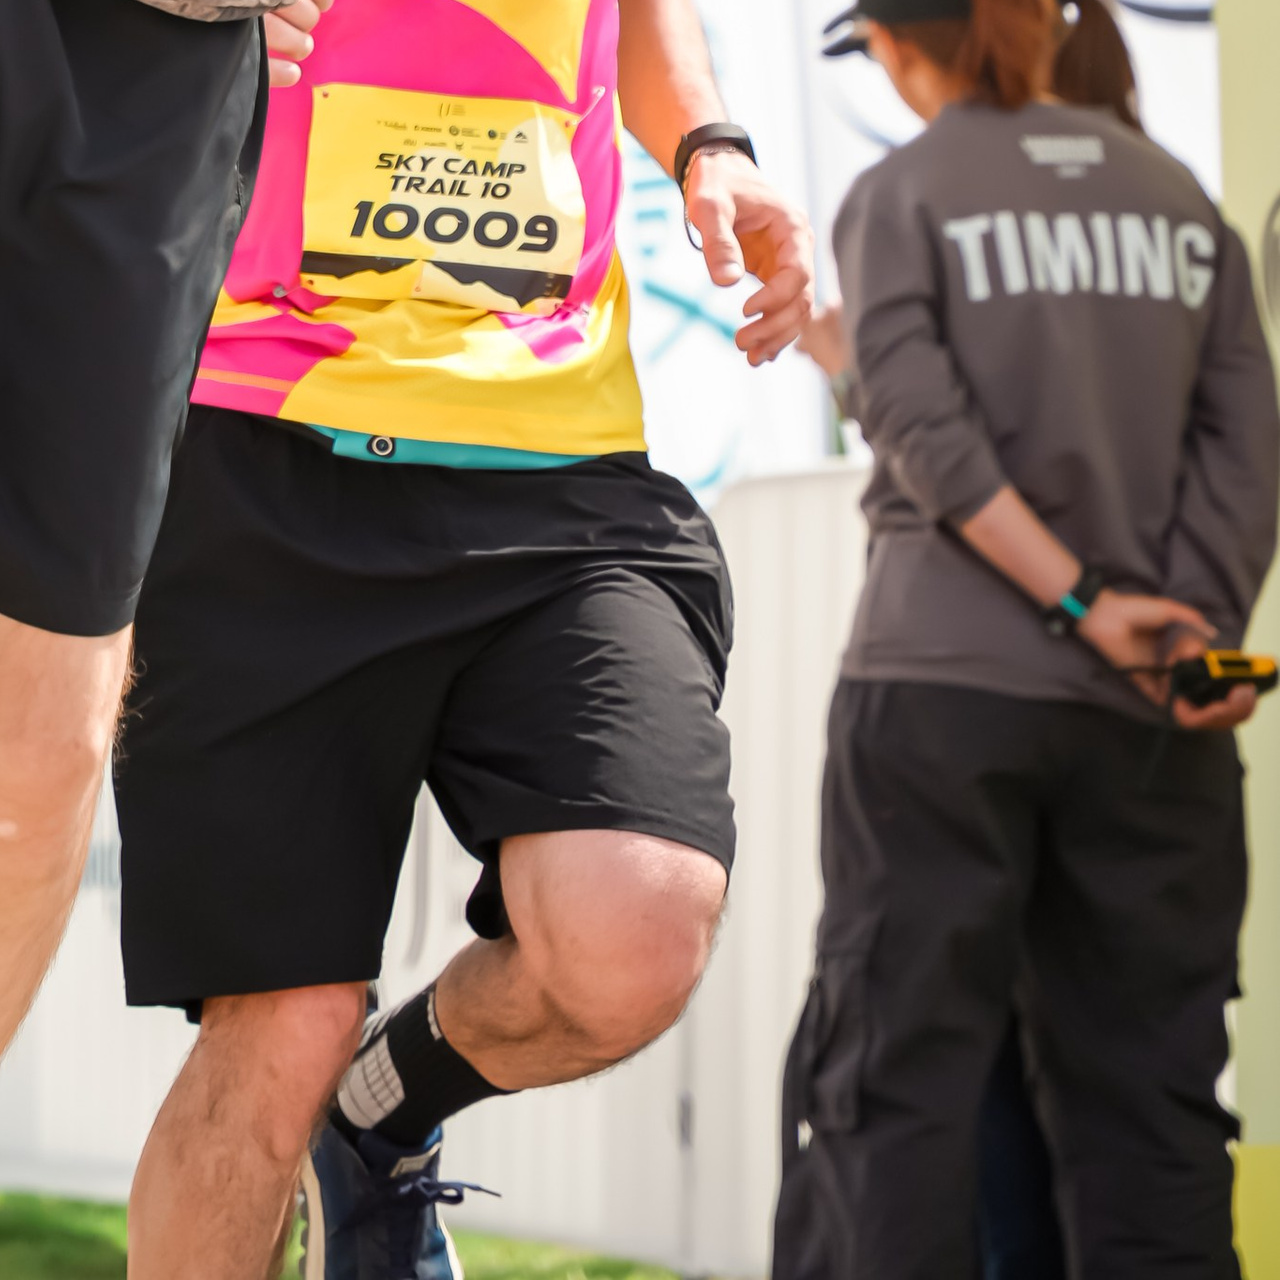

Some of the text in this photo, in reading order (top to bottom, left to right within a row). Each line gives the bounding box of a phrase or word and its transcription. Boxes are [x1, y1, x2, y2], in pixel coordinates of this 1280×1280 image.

[375, 152, 527, 179] SKY CAMP
[390, 174, 512, 200] TRAIL 10
[350, 200, 558, 253] 10009
[943, 210, 1216, 310] TIMING
